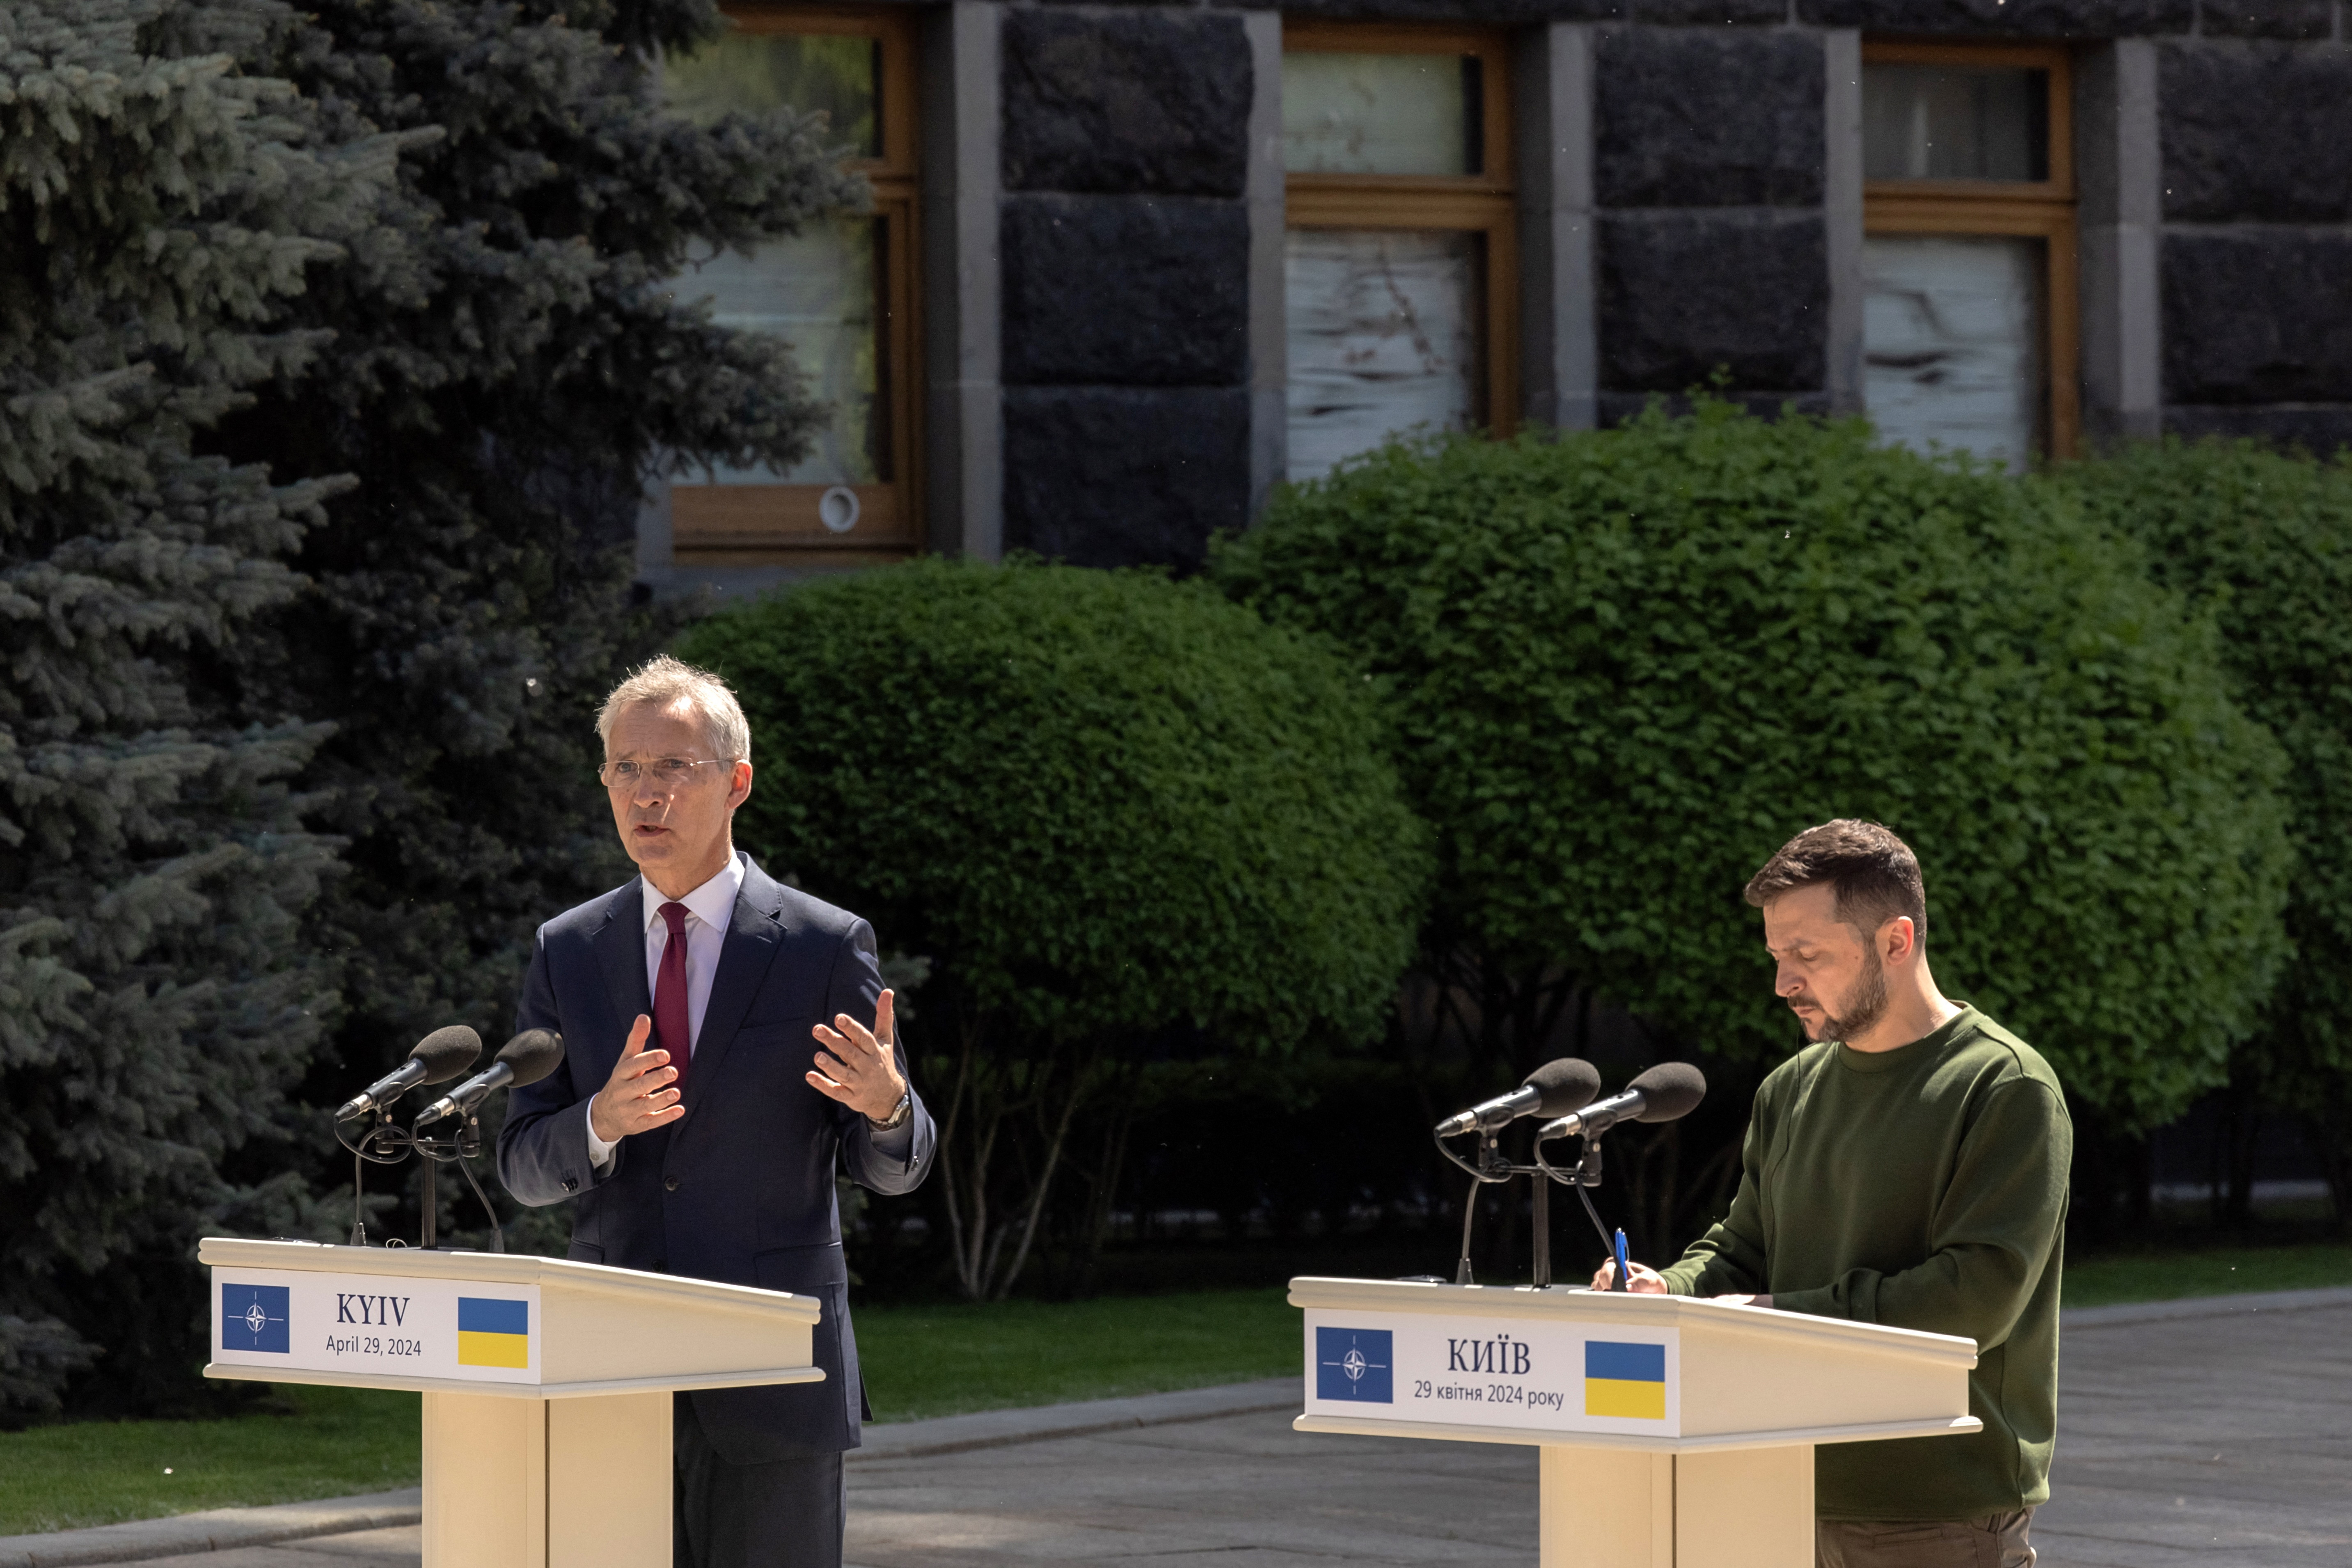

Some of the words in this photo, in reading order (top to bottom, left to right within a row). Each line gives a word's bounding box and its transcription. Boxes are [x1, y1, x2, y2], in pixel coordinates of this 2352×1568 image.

[336, 1293, 411, 1327] KYIV
[325, 1335, 359, 1356] April
[363, 1337, 383, 1357] 29,
[387, 1338, 421, 1357] 2024
[1447, 1333, 1531, 1375] КИЇВ
[1414, 1380, 1432, 1399] 29
[1436, 1383, 1482, 1401] квітня
[1487, 1384, 1523, 1404] 2024
[1528, 1391, 1564, 1411] року
